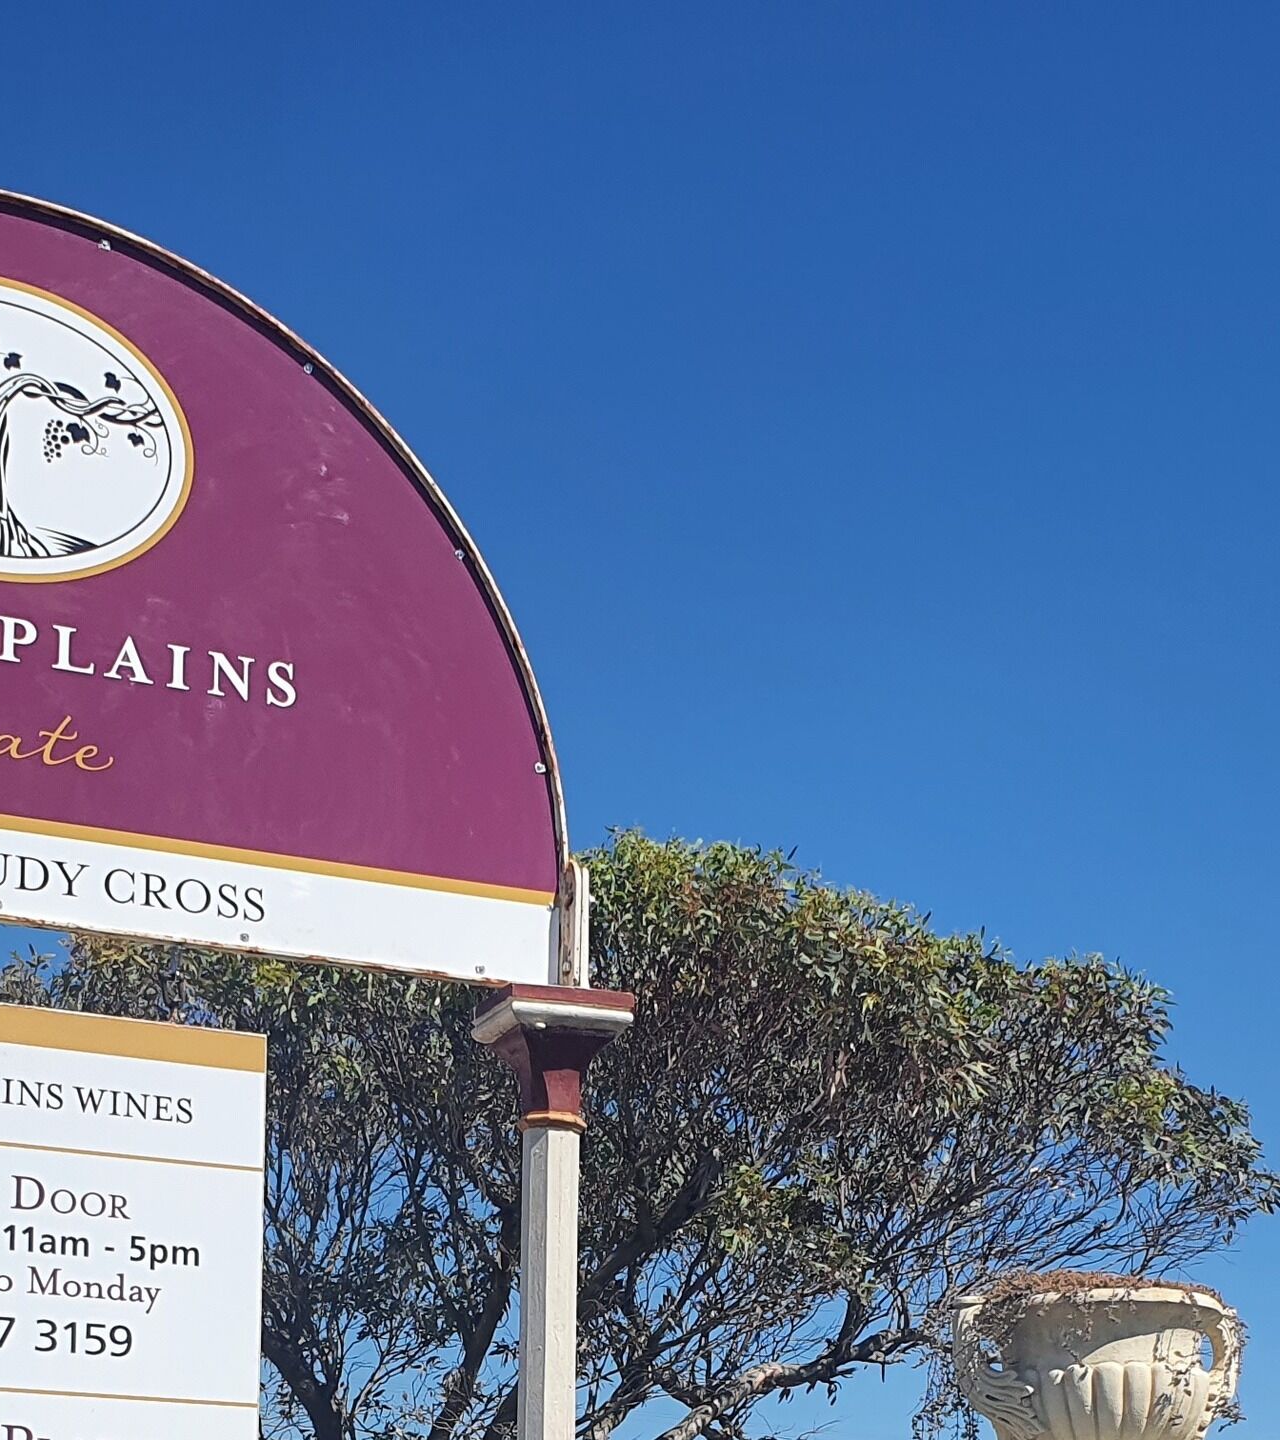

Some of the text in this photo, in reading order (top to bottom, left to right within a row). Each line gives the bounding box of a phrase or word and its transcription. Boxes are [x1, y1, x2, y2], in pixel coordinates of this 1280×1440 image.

[104, 868, 265, 923] CROSS
[73, 1086, 193, 1124] WINES
[3, 1224, 89, 1258] 11am
[129, 1235, 200, 1271] 5pm
[27, 1265, 161, 1314] Monday
[34, 1319, 132, 1357] 3159
